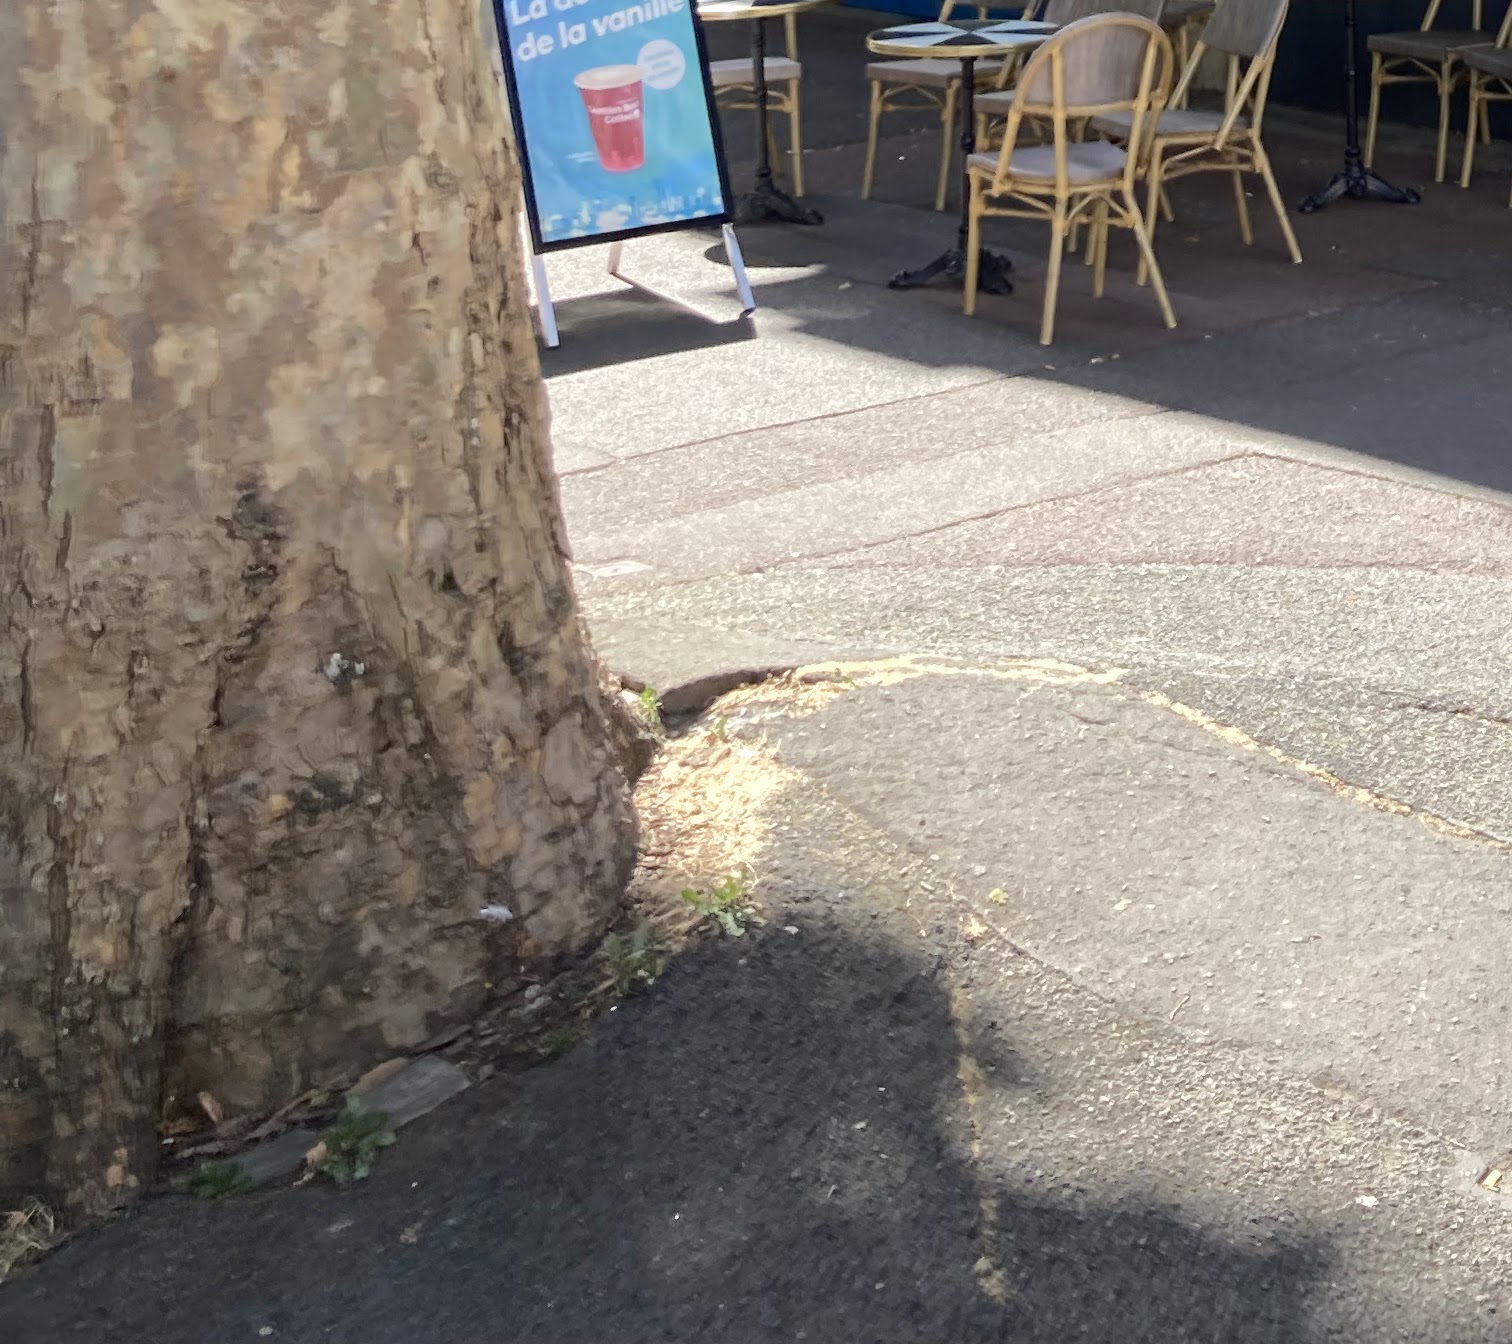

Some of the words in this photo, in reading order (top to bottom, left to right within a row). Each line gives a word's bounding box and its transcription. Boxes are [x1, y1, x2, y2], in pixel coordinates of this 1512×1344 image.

[510, 0, 548, 26] La
[517, 32, 554, 62] de
[558, 21, 587, 48] la
